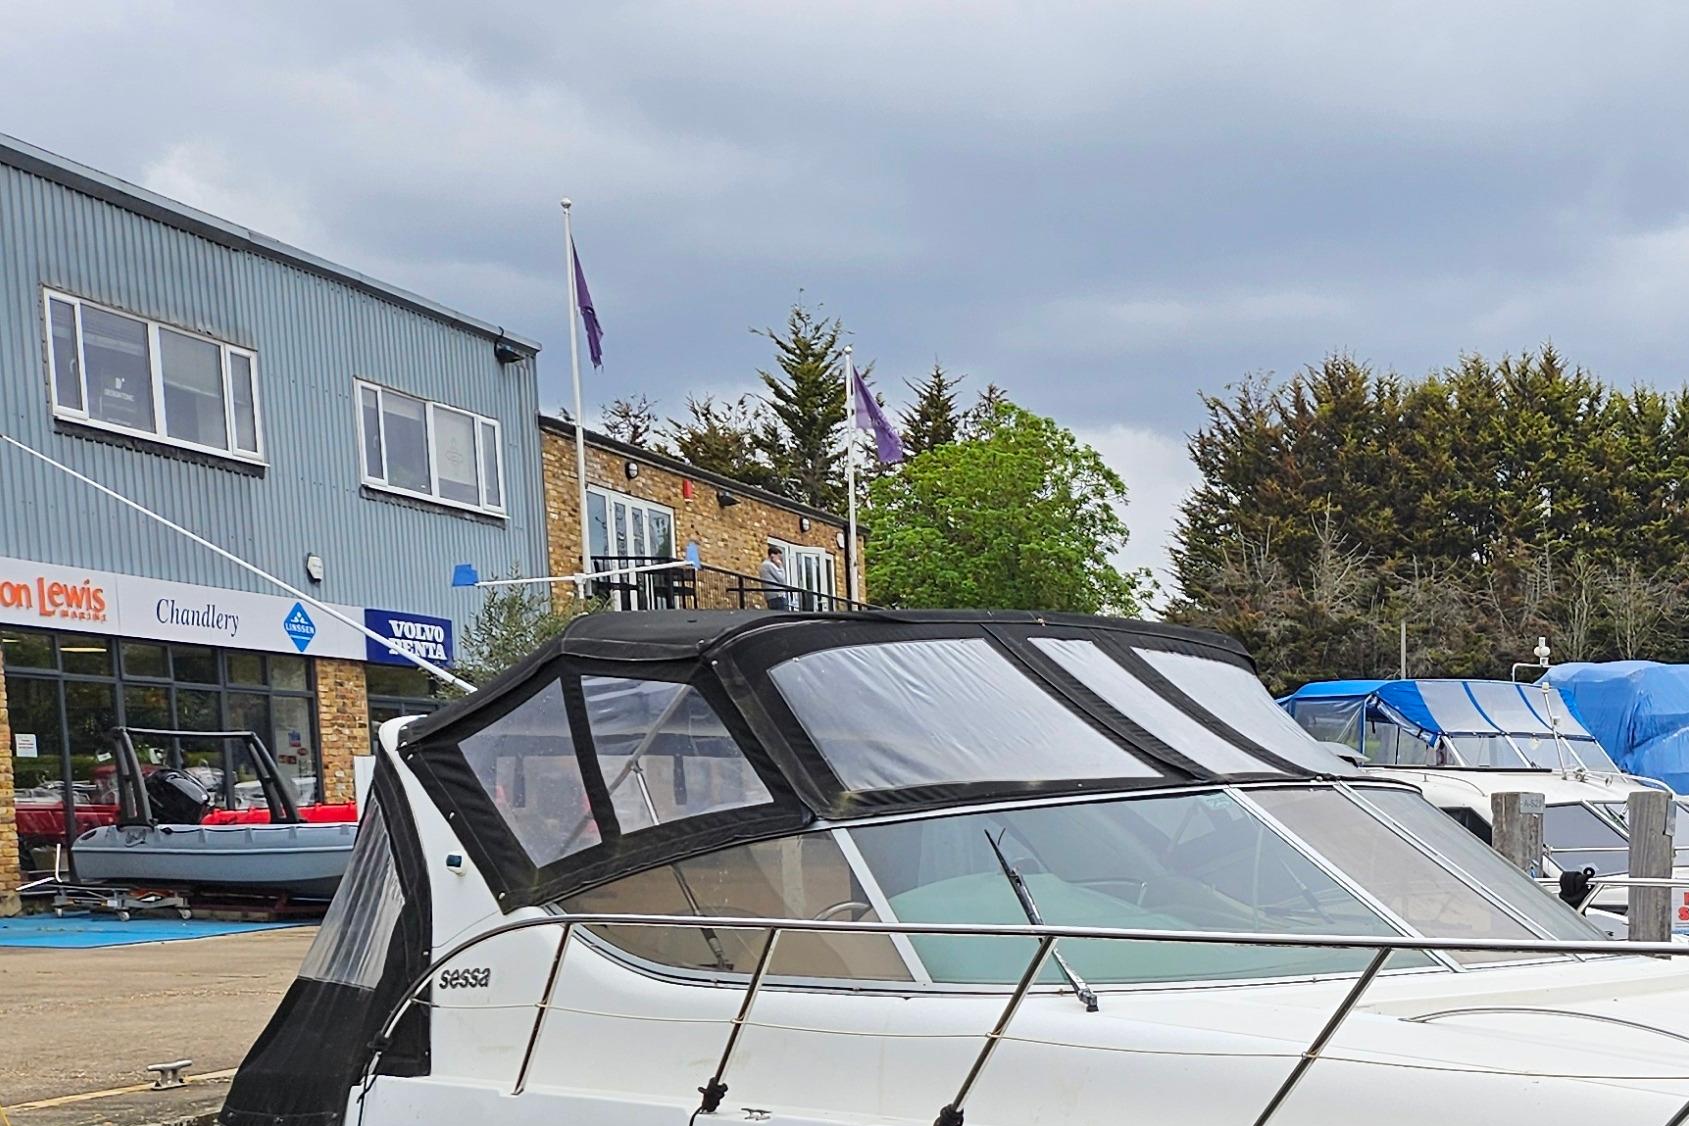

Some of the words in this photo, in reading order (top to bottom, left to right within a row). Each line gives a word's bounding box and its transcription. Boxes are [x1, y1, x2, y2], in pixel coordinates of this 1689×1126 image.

[37, 577, 106, 616] Lewis
[156, 598, 239, 637] Chandlery
[388, 619, 445, 643] VOLVO
[439, 967, 491, 990] sessa
